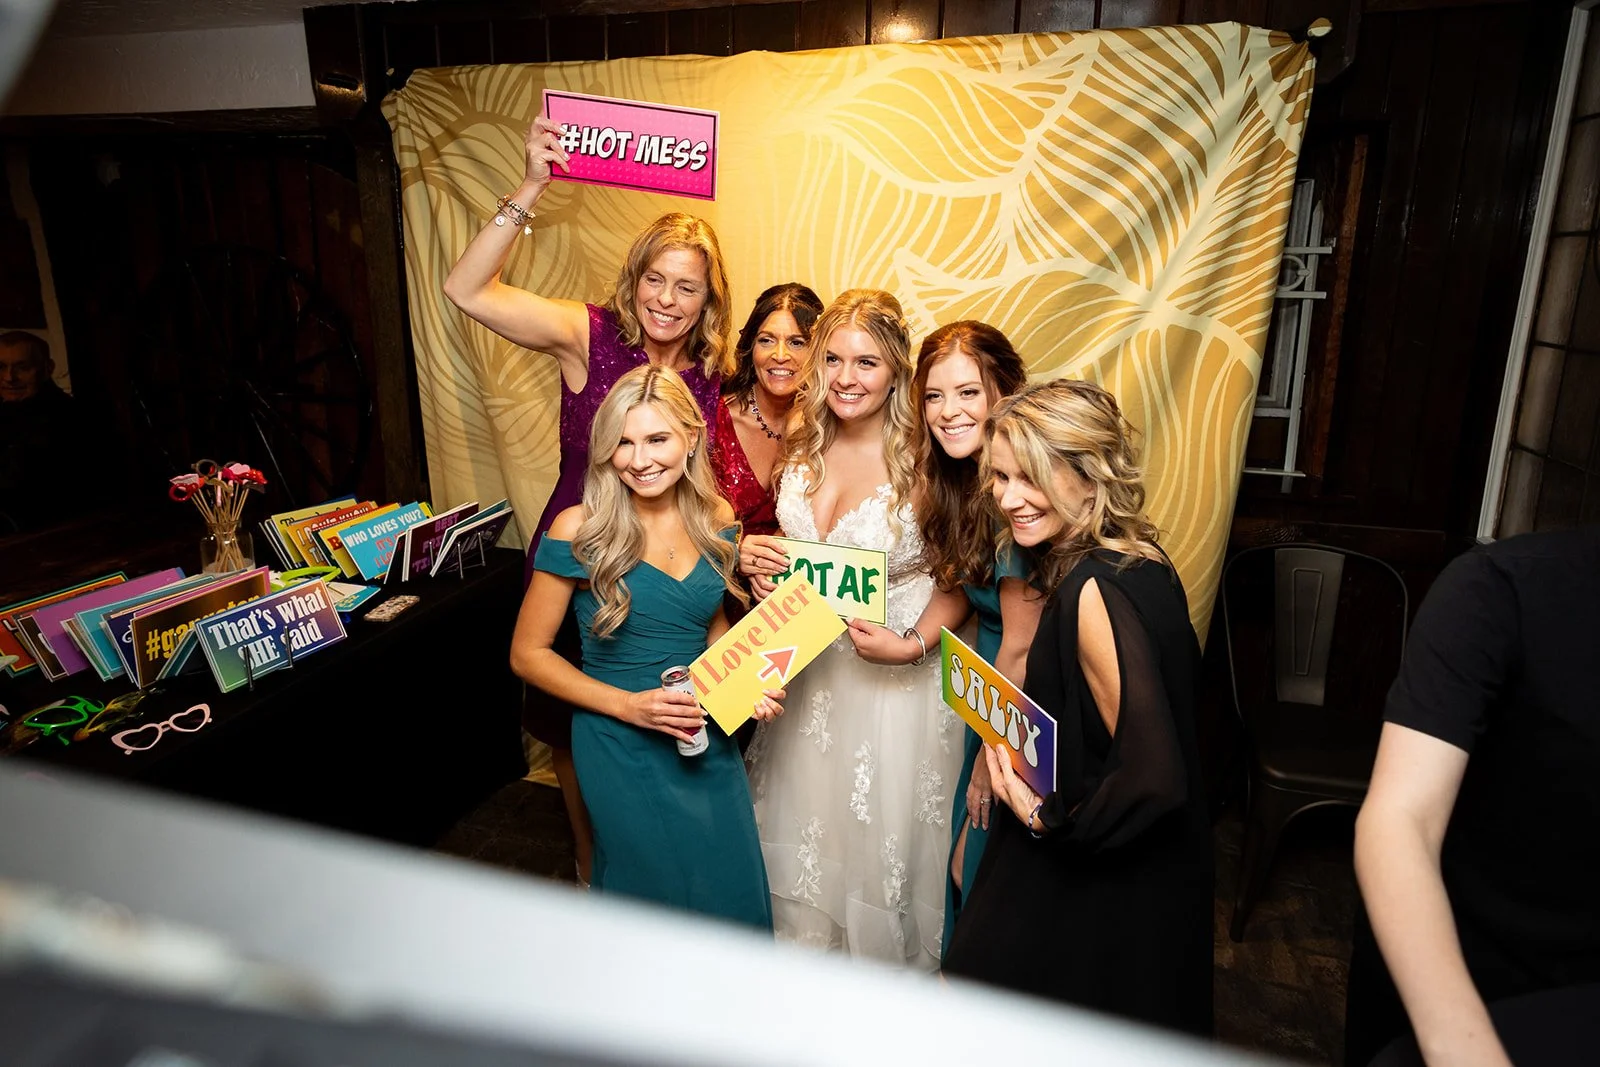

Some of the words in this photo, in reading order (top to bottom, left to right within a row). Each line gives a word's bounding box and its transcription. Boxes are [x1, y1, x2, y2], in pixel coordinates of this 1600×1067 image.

[559, 123, 633, 160] #HOT
[633, 134, 709, 171] MESS
[344, 530, 368, 548] WHO
[367, 518, 399, 539] LOVES
[397, 508, 422, 526] YOU?
[836, 564, 880, 605] AF
[207, 608, 277, 650] That's
[275, 586, 328, 624] what
[700, 625, 768, 685] Love
[757, 583, 811, 634] Her
[950, 652, 1041, 768] SALTY
